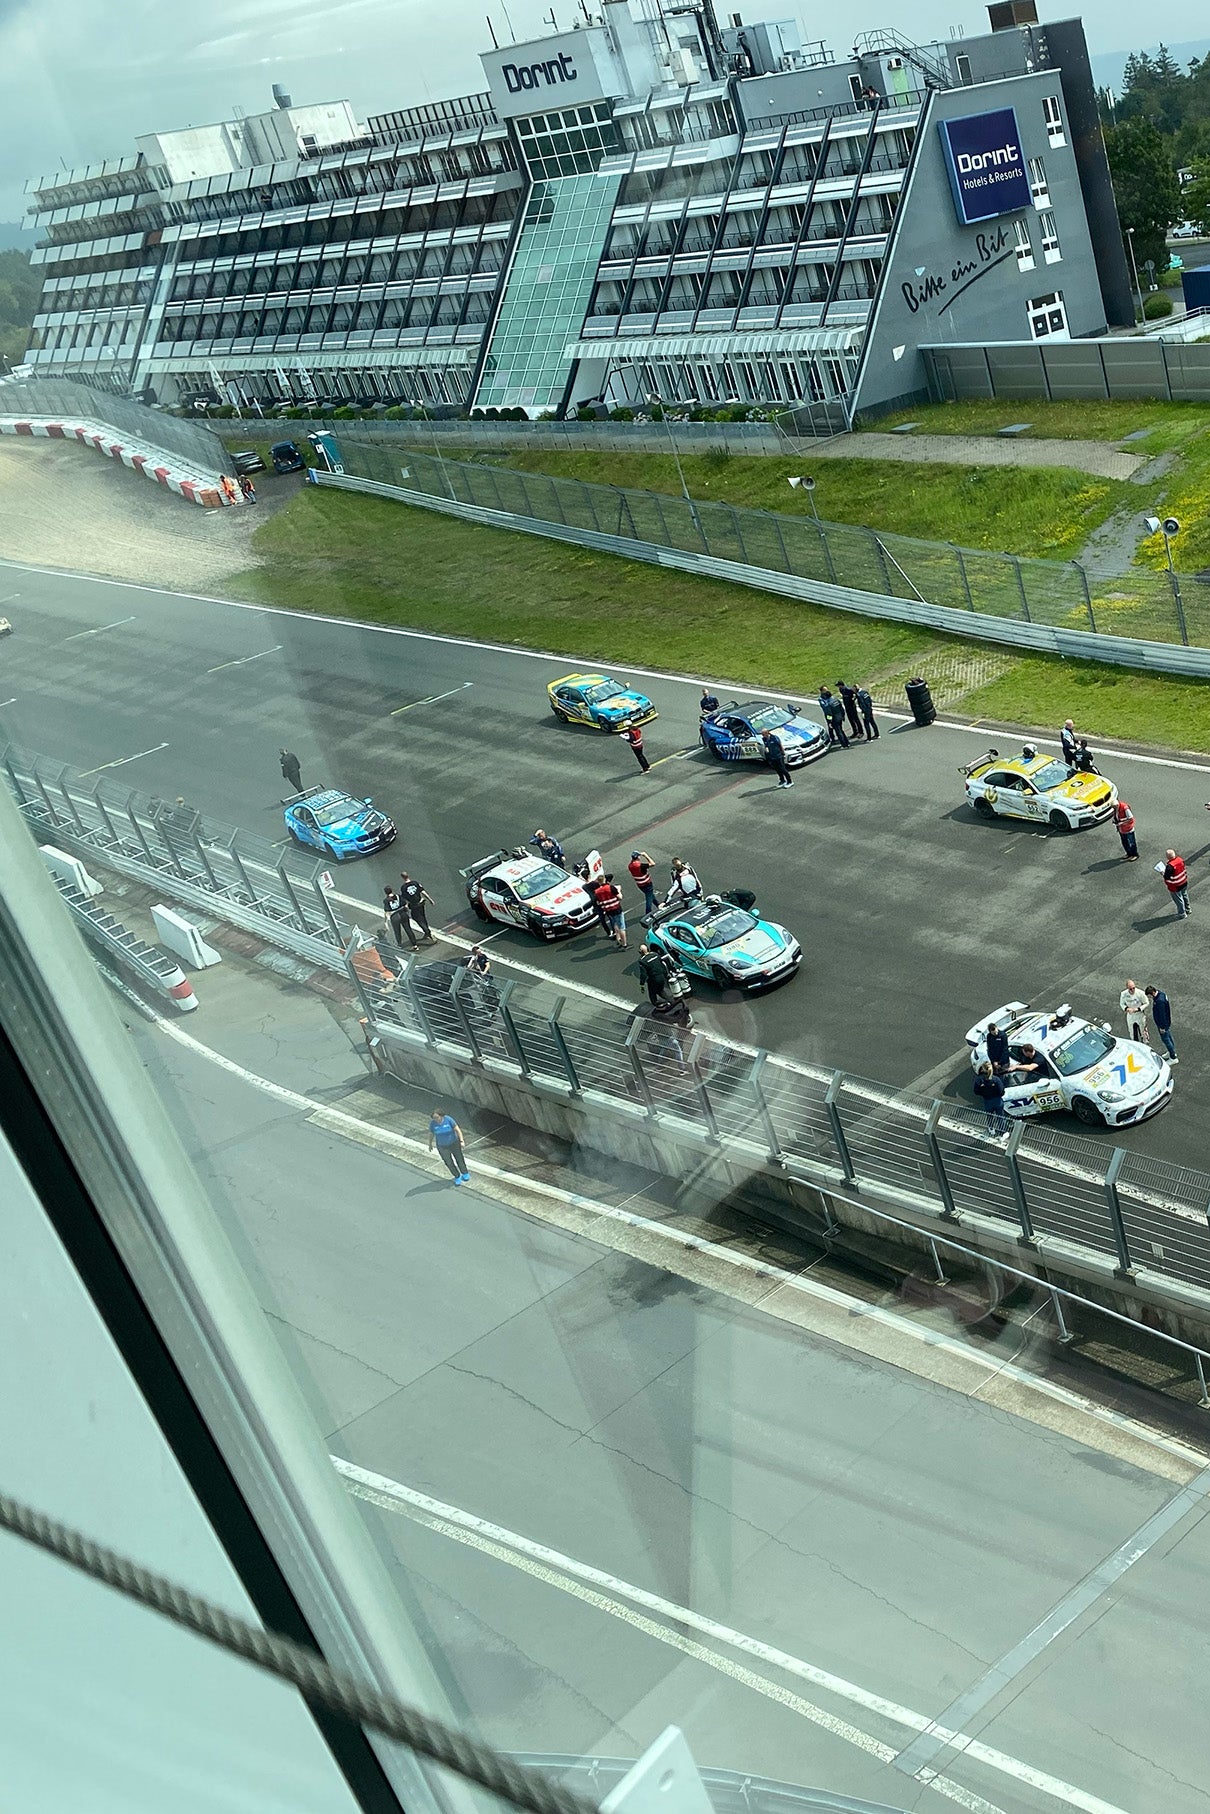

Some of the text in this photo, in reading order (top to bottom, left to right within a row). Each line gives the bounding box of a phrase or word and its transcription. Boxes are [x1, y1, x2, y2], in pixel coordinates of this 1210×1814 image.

[501, 52, 577, 93] Dorint
[957, 143, 1019, 174] Dorint
[963, 175, 988, 190] Hotels
[994, 167, 1023, 183] Resorts
[901, 226, 1009, 313] Bitte ein Bit
[1088, 1071, 1105, 1084] 956
[1039, 1096, 1060, 1106] 956
